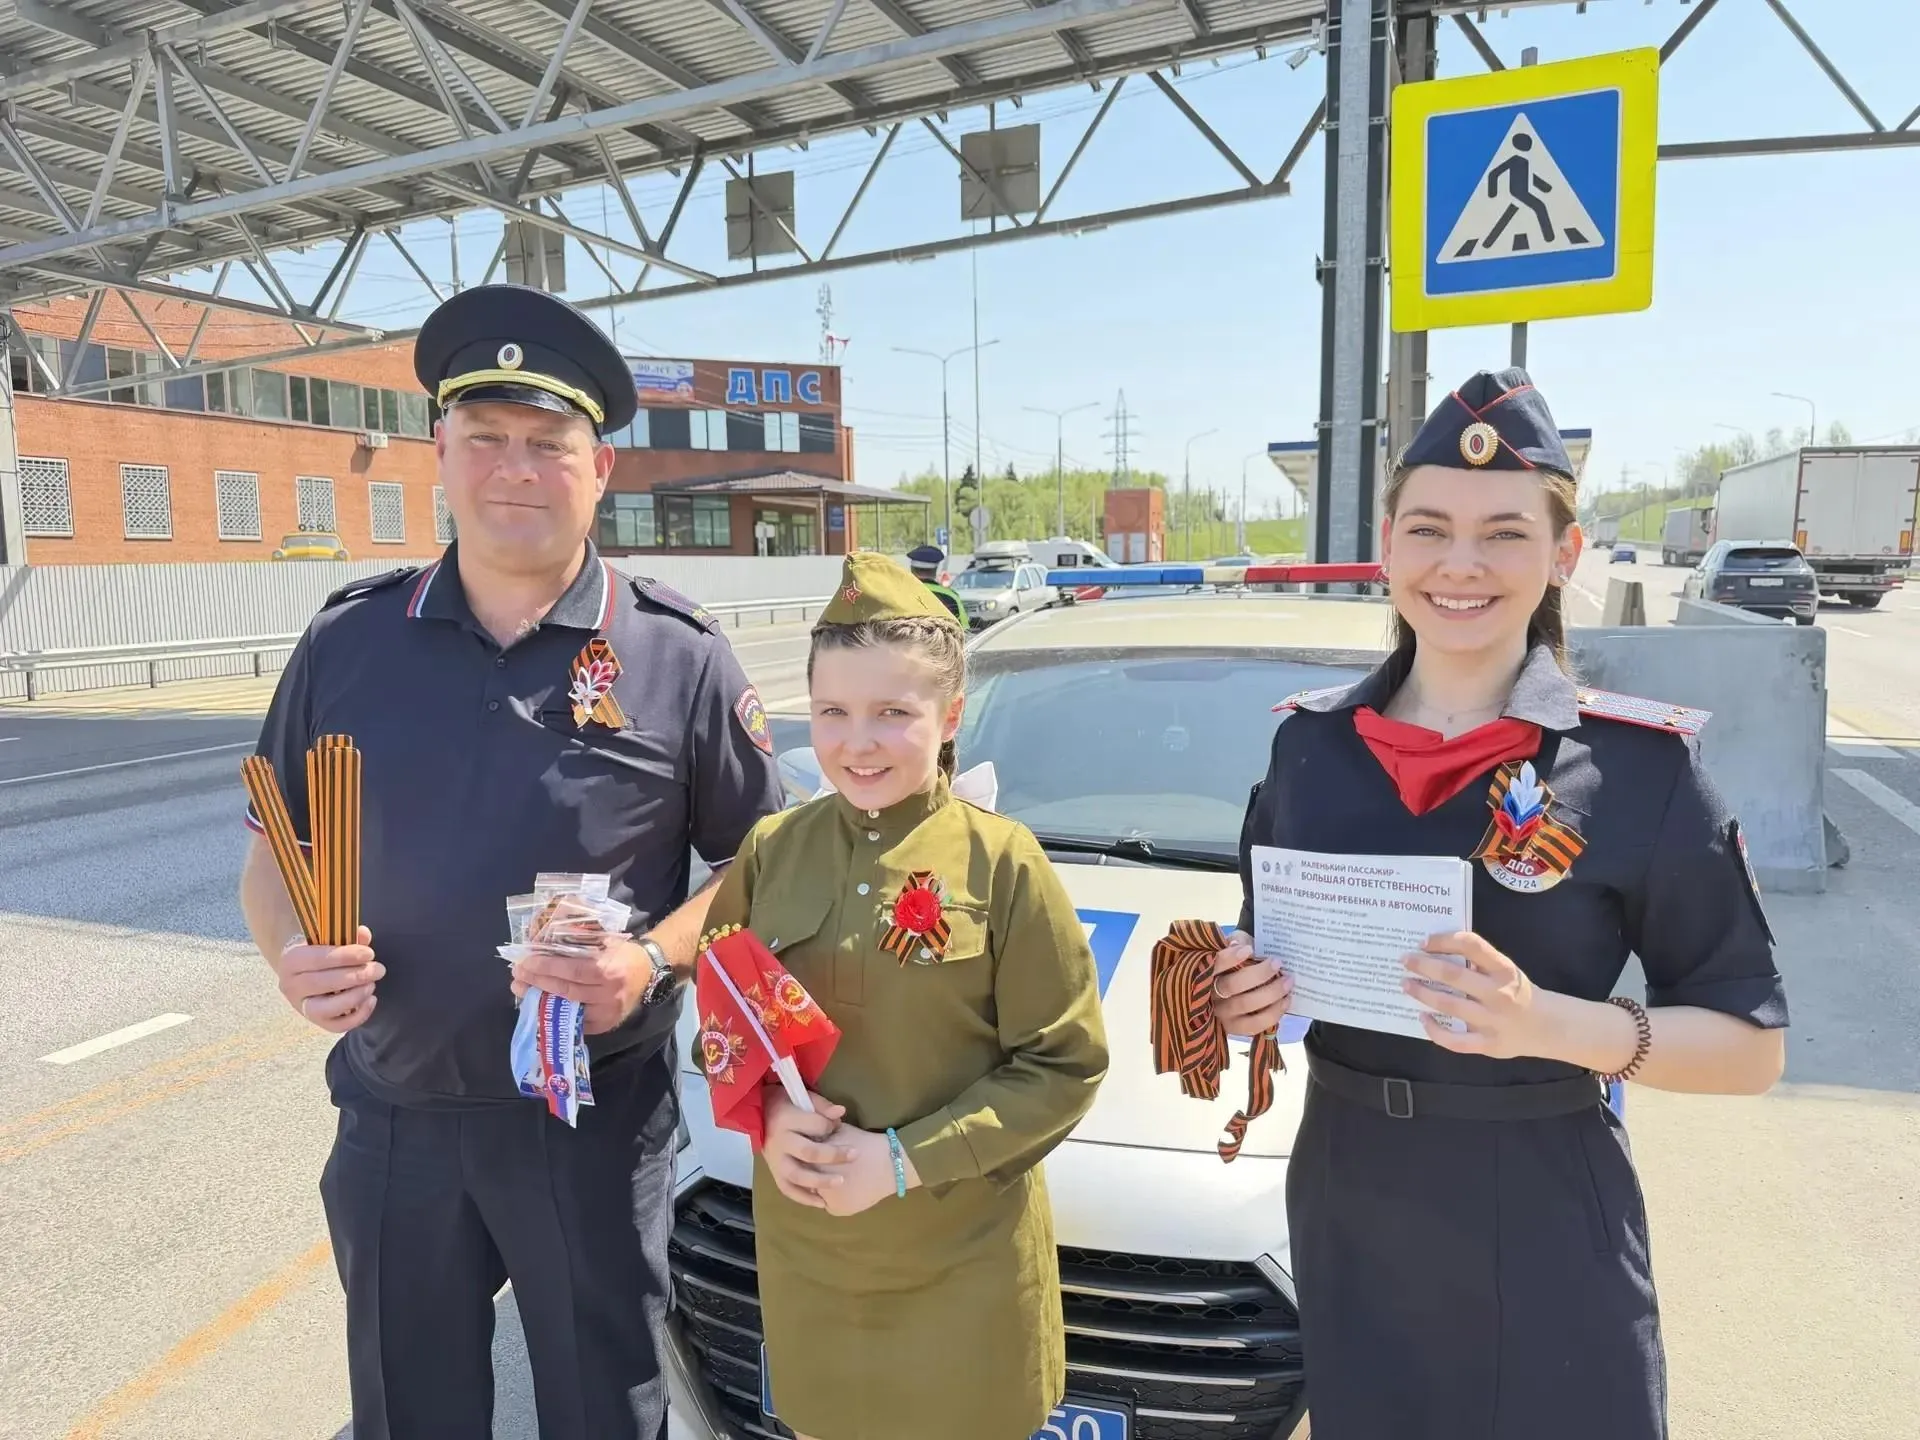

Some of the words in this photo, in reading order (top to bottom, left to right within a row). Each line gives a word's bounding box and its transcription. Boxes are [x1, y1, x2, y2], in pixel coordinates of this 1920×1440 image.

[726, 367, 823, 406] ДПС
[1301, 860, 1346, 873] МАЛЕНЬКИЙ
[1347, 865, 1394, 876] ПАССАЖИР
[1493, 868, 1537, 889] 50-2124
[1505, 858, 1534, 876] ДПС
[1301, 871, 1345, 885] БОЛЬШАЯ
[1347, 877, 1451, 896] ОТВЕТСТВЕННОСТЬ!
[1261, 883, 1293, 895] ПРАВИЛА
[1293, 888, 1336, 902] ПЕРЕВОЗКИ
[1337, 895, 1378, 908] РЕБЕНКА
[1380, 899, 1386, 908] В
[1388, 901, 1453, 916] АВТОМОБИЛЕ
